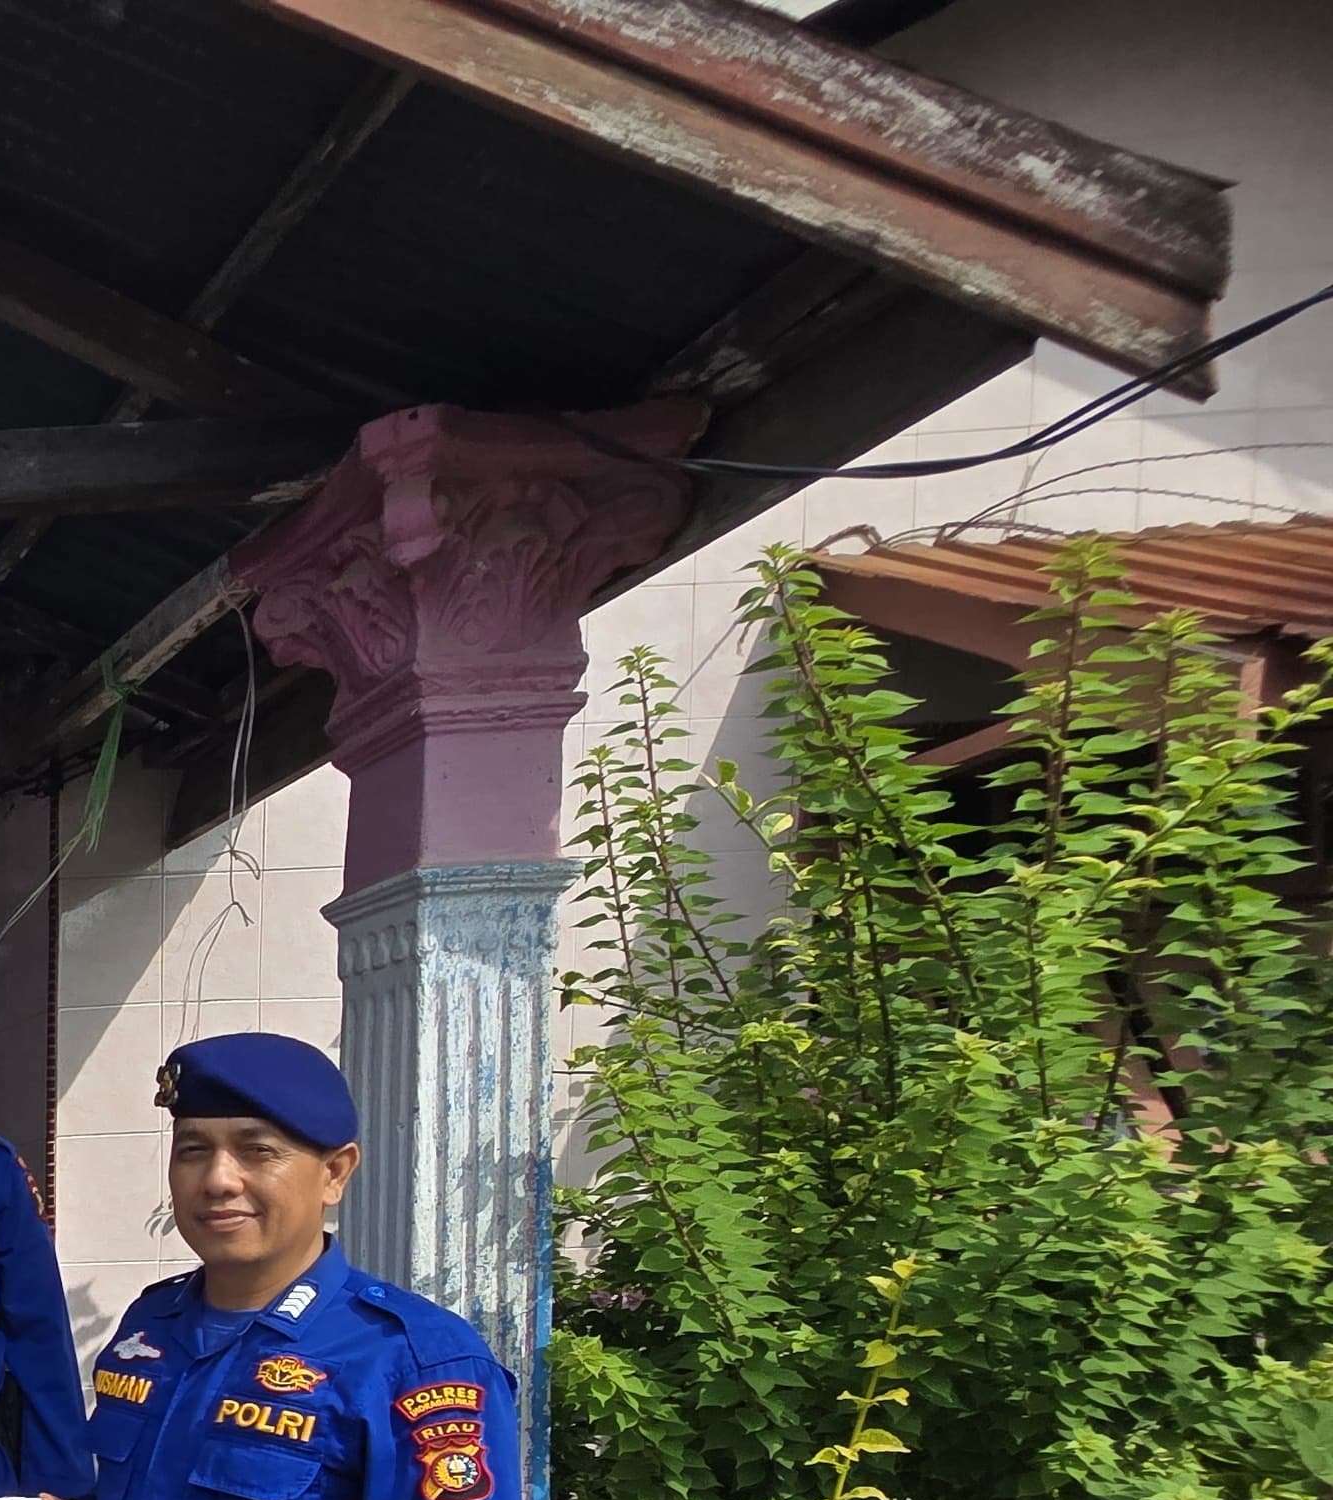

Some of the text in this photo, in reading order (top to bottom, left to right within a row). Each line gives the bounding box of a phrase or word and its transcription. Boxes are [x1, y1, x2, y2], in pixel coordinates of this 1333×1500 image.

[403, 1387, 477, 1410] POLRES
[214, 1399, 316, 1442] POLRI
[421, 1423, 475, 1439] RIAU
